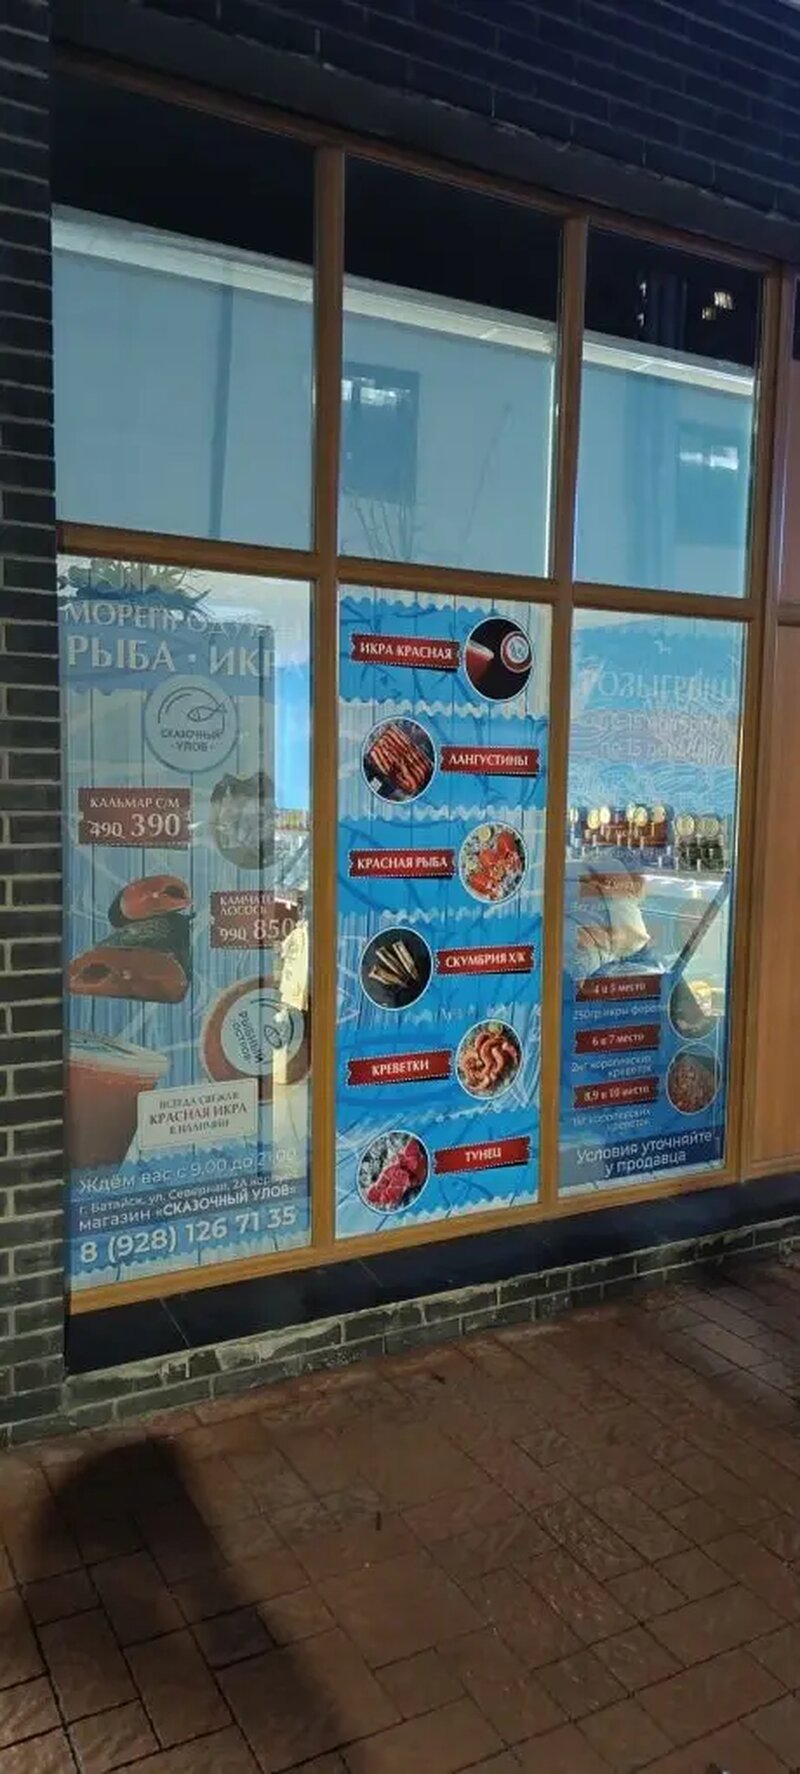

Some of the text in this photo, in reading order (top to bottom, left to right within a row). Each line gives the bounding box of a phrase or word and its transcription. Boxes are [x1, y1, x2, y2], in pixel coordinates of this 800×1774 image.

[66, 634, 176, 672] РЫБА
[360, 641, 452, 660] ИКРА КРАСНАЯ
[160, 727, 222, 741] СКАЗОЧНЫЙ
[175, 740, 209, 753] УЛОВ
[449, 751, 529, 767] ЛАНГУСТИНЫ
[90, 797, 180, 810] КАЛЬМАР С/М
[90, 813, 180, 839] 490 390
[357, 855, 448, 870] КРАСНАЯ РЫБА
[220, 917, 295, 942] 990 850
[445, 950, 526, 968] СКУМБРИЯ Х/К
[371, 1060, 430, 1077] КРЕВЕТКИ
[149, 1101, 248, 1126] КРАСНАЯ ИКРА
[464, 1147, 502, 1164] ТУНЕЦ
[576, 1130, 713, 1165] Условия уточняйте
[604, 1149, 687, 1178] у продавца
[78, 1174, 136, 1195] Ждём
[141, 1168, 171, 1184] вас
[177, 1167, 188, 1178] с
[190, 1158, 227, 1178] 9.00
[230, 1157, 253, 1173] до
[79, 1208, 151, 1233] магазин
[80, 1205, 297, 1264] 8 (928) 126 71 35
